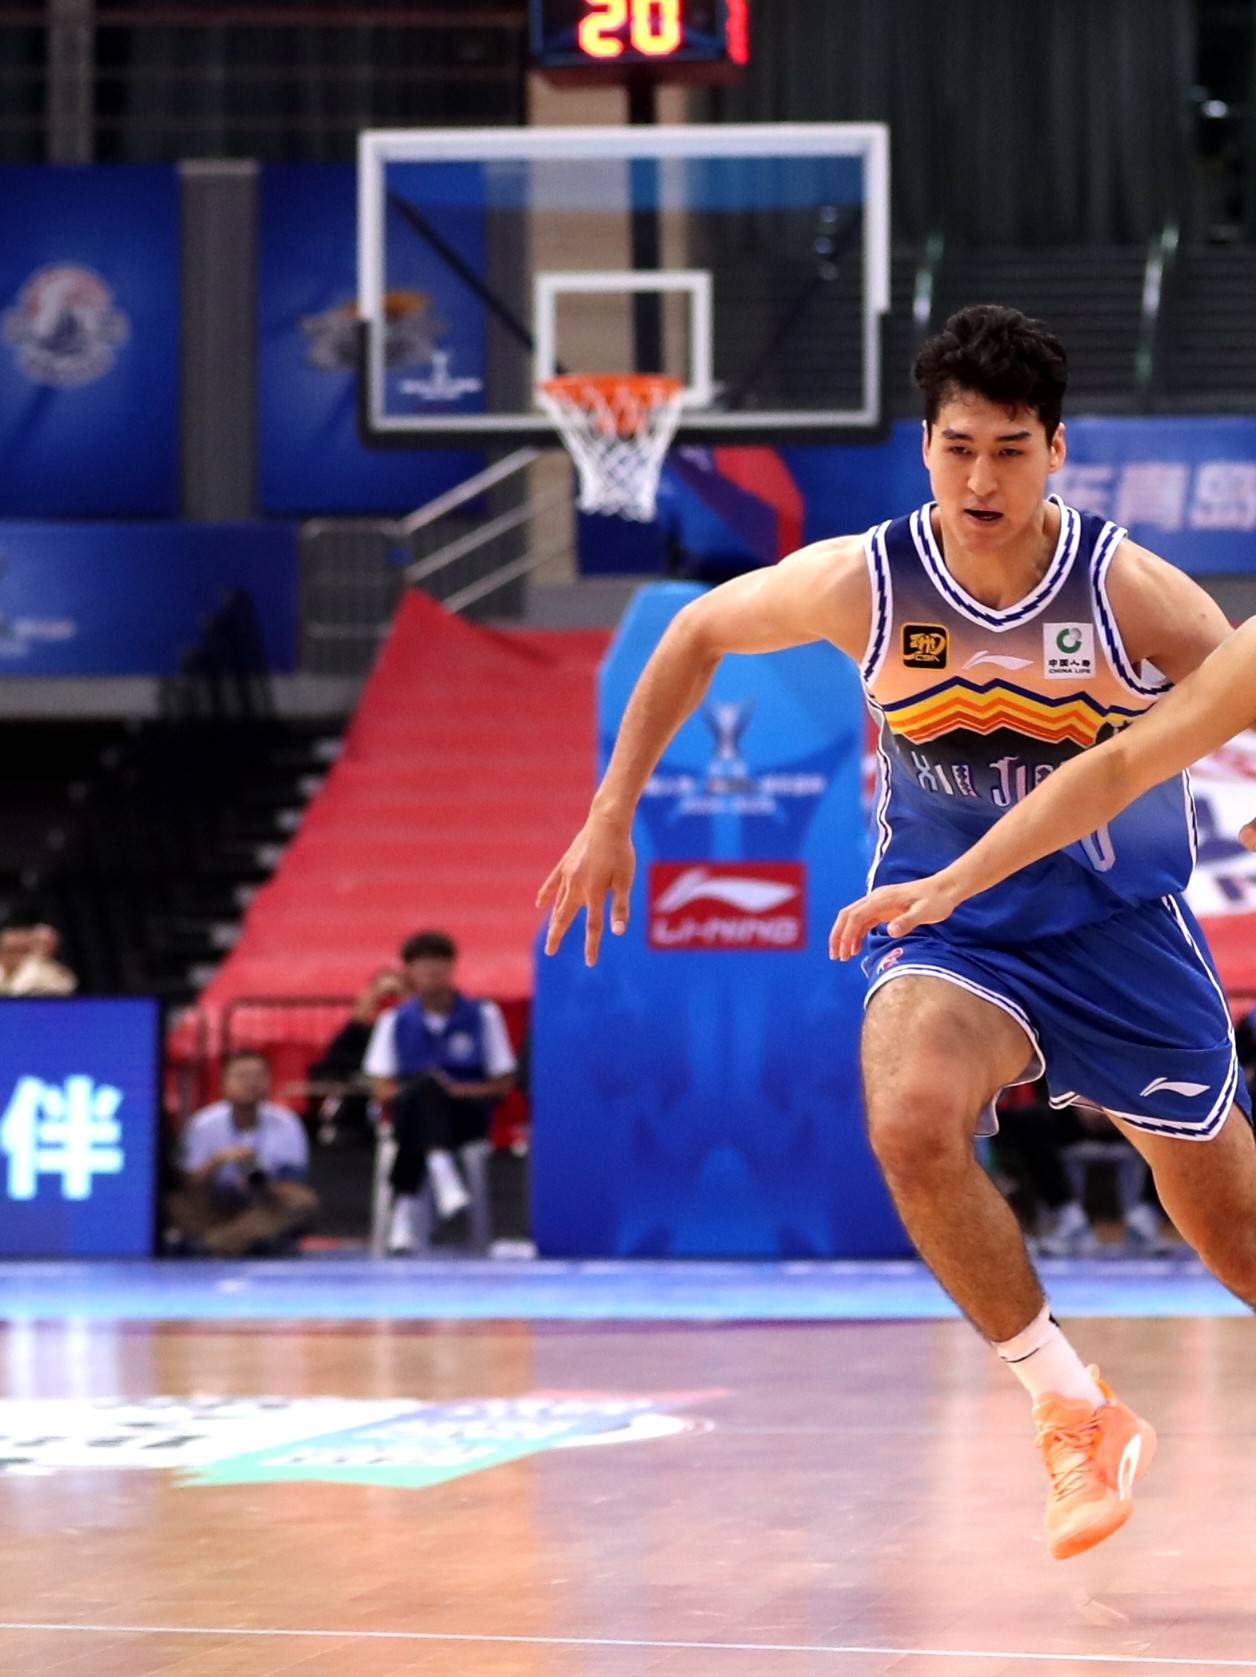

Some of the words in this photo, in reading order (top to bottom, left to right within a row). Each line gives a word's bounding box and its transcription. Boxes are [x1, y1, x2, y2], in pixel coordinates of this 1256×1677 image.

[578, 0, 682, 57] 20
[652, 917, 799, 945] LI-NING
[0, 1074, 125, 1200] 伴
